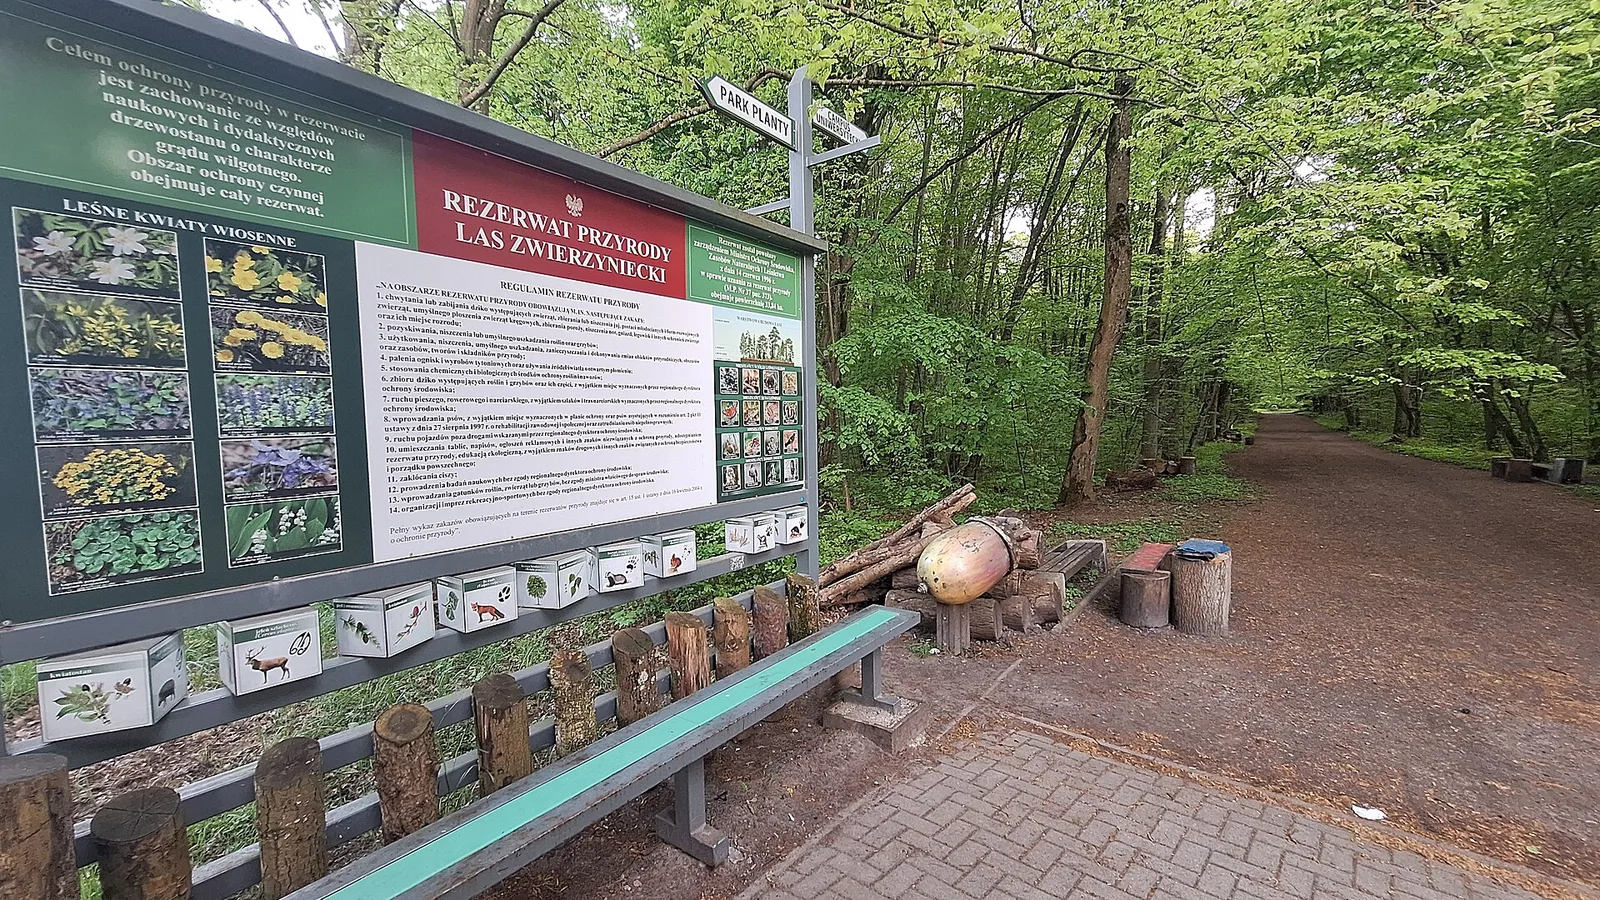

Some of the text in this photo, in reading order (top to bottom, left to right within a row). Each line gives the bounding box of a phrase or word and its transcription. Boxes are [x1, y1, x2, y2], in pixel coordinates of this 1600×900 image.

[46, 37, 366, 141] Celem ochrony przyrody w rezerwacie
[98, 70, 333, 146] jest zachowanie ze względów
[720, 85, 788, 136] PARK PLANTY
[103, 92, 335, 162] naukowych i dydaktycznych
[828, 111, 850, 132] CAMPUS
[816, 112, 861, 144] UNIWERSYTECK
[110, 109, 332, 175] drzewostanu o charakterze
[155, 141, 302, 183] grądu wilgotnego.
[128, 150, 324, 205] Obszar ochrony czynnej
[131, 169, 325, 218] obejmuje cały rezerwat.
[63, 198, 298, 248] LEŚNE KWIATY WIOSENNE
[442, 188, 672, 264] REZERWAT PRZYRODY
[454, 222, 667, 284] LAS ZWIERZYNIECKI
[376, 281, 394, 290] „NA
[394, 283, 440, 297] OBSZARZE
[441, 290, 489, 303] REZERWATU
[489, 296, 527, 308] PRZYRODY
[500, 281, 554, 296] REGULAMIN
[377, 292, 384, 300] 1.
[385, 293, 424, 304] chwytania
[425, 298, 437, 306] lub
[377, 303, 412, 314] zwierząt,
[396, 313, 408, 322] ich
[408, 315, 432, 325] miejsc
[378, 322, 386, 330] 2.
[387, 325, 439, 335] pozyskiwania,
[379, 333, 387, 341] 3.
[387, 334, 437, 345] użytkowania,
[397, 345, 431, 354] zasobów,
[388, 355, 416, 363] palenia
[416, 356, 440, 364] ognisk
[381, 364, 388, 372] 5.
[390, 375, 414, 383] zbioru
[416, 376, 437, 384] dziko
[381, 385, 412, 394] ochrony
[382, 395, 390, 403] 7.
[414, 395, 446, 404] pieszego,
[383, 405, 413, 414] ochrony
[392, 415, 445, 424] wprowadzania
[384, 426, 410, 434] ustawy
[416, 424, 433, 432] dnia
[393, 435, 416, 443] ruchu
[416, 434, 450, 444] pojazdów
[386, 446, 397, 454] 10.
[398, 444, 445, 453] umieszczania
[386, 455, 424, 463] rezerwatu
[390, 464, 426, 474] porządku
[400, 472, 438, 482] zakłócania
[400, 482, 446, 494] prowadzenia
[389, 496, 400, 504] 13.
[400, 491, 452, 504] wprowadzania
[401, 501, 441, 513] organizacji
[390, 519, 463, 535] Pełny wykaz zakazów
[396, 532, 426, 543] ochronie
[426, 527, 459, 540] przyrody”.
[50, 668, 92, 679] kwiatostan
